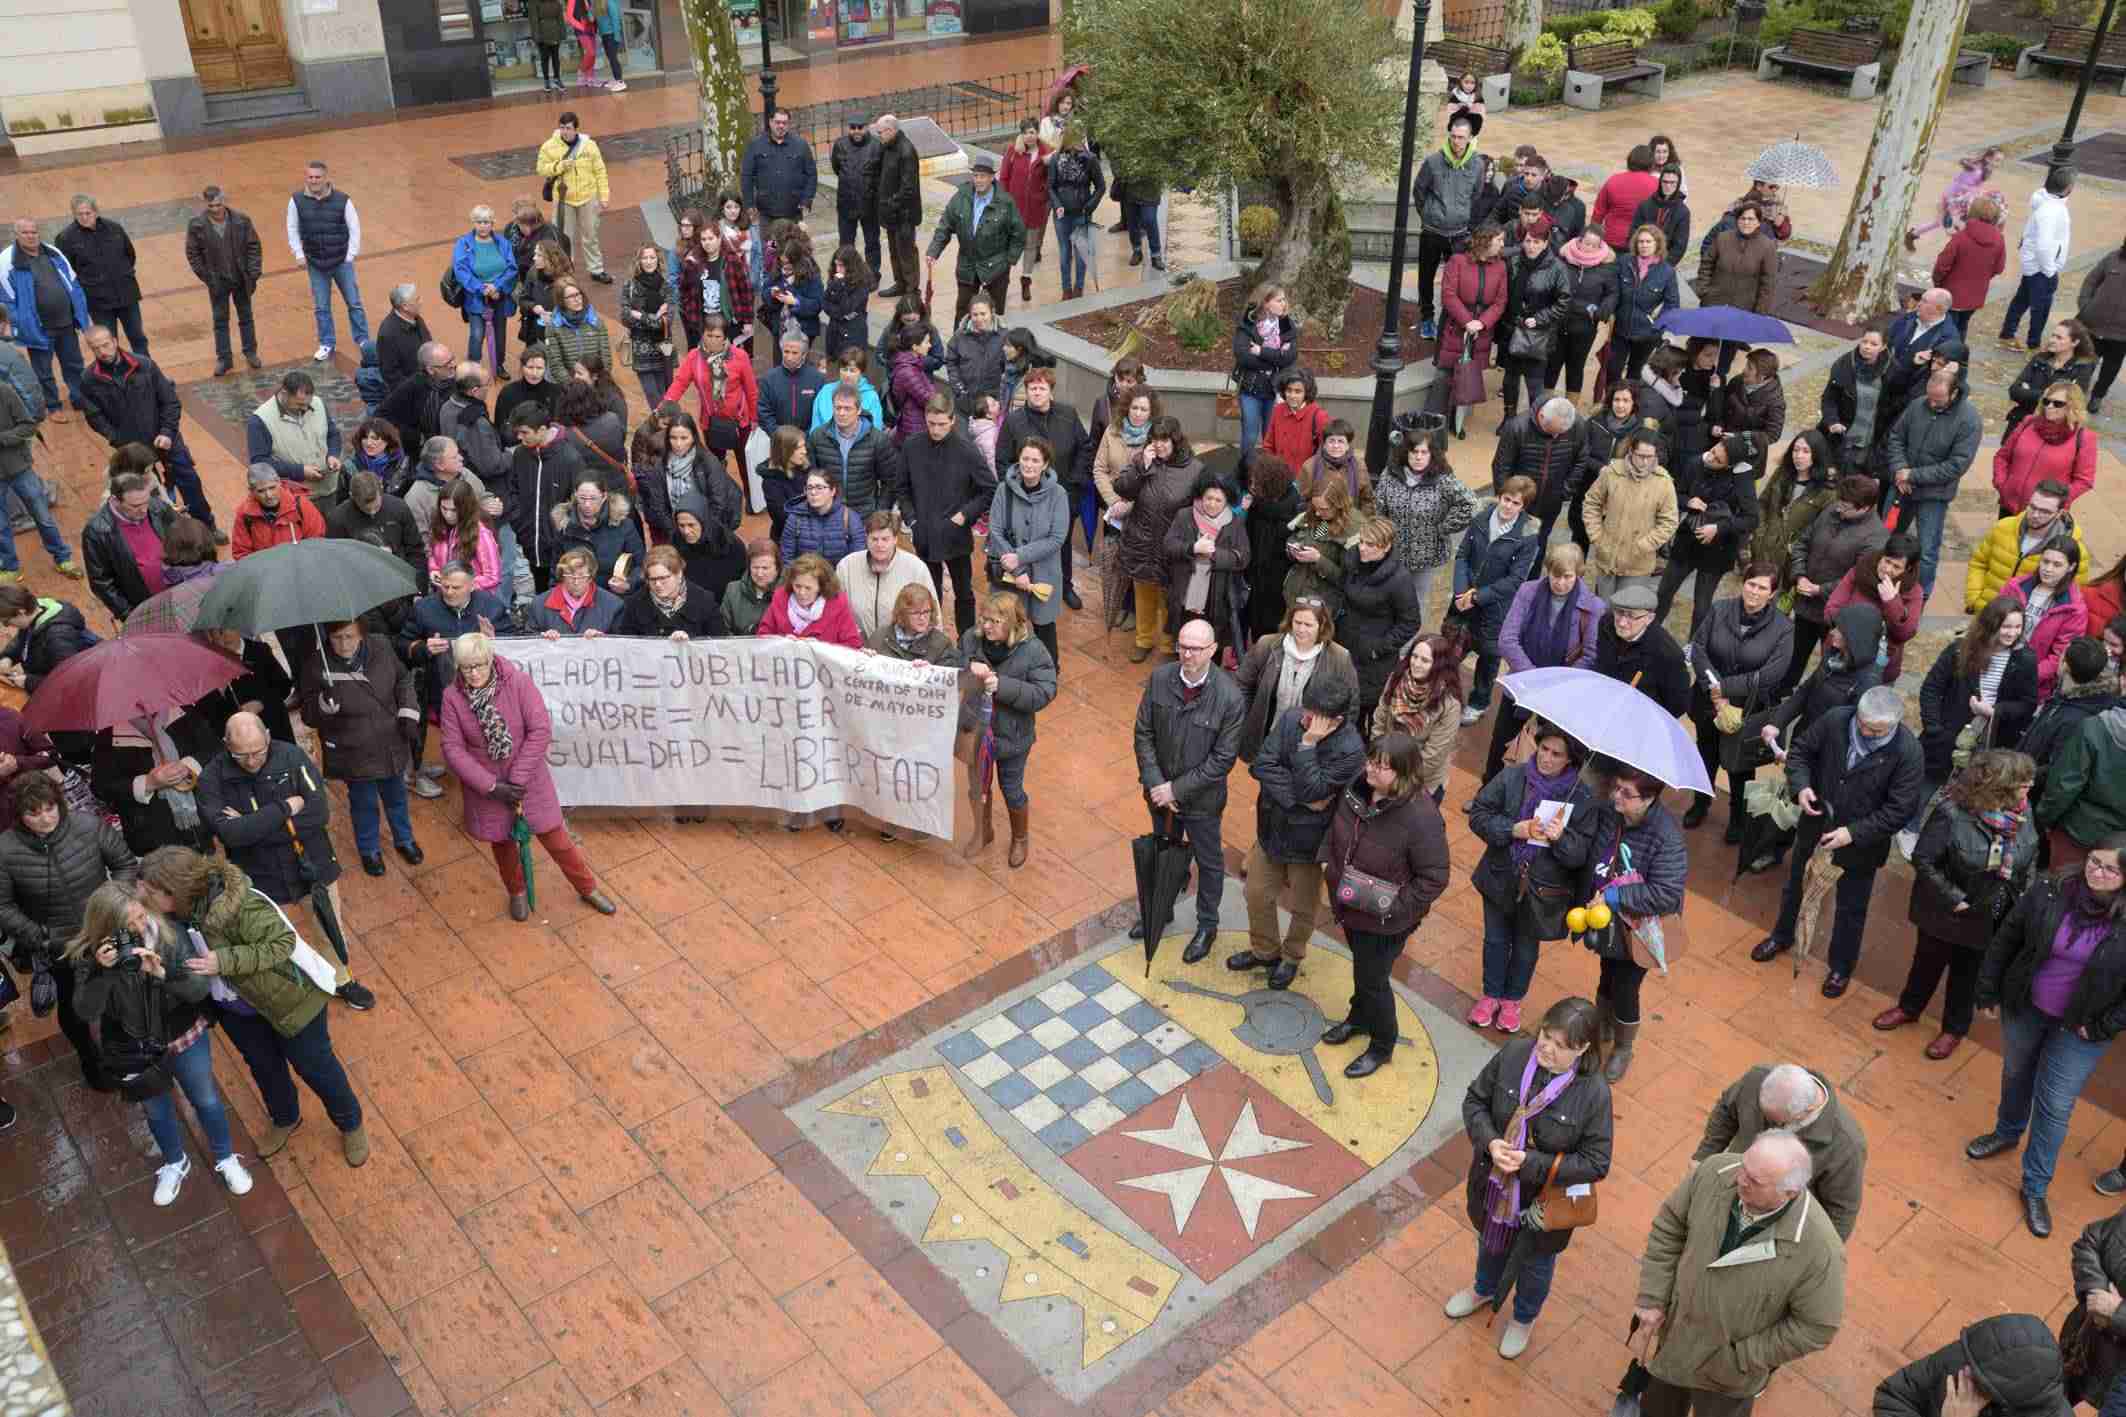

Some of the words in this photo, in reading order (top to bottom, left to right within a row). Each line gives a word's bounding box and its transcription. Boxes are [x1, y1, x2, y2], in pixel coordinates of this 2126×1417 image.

[511, 656, 622, 692] ILADA
[664, 653, 834, 690] JUBILADO
[550, 700, 658, 731] OMBRE
[704, 693, 840, 730] MUJER
[845, 691, 863, 706] DE
[870, 699, 945, 719] MAYORES
[545, 738, 712, 769] GUALDAD
[760, 734, 941, 803] LIBERTAD
